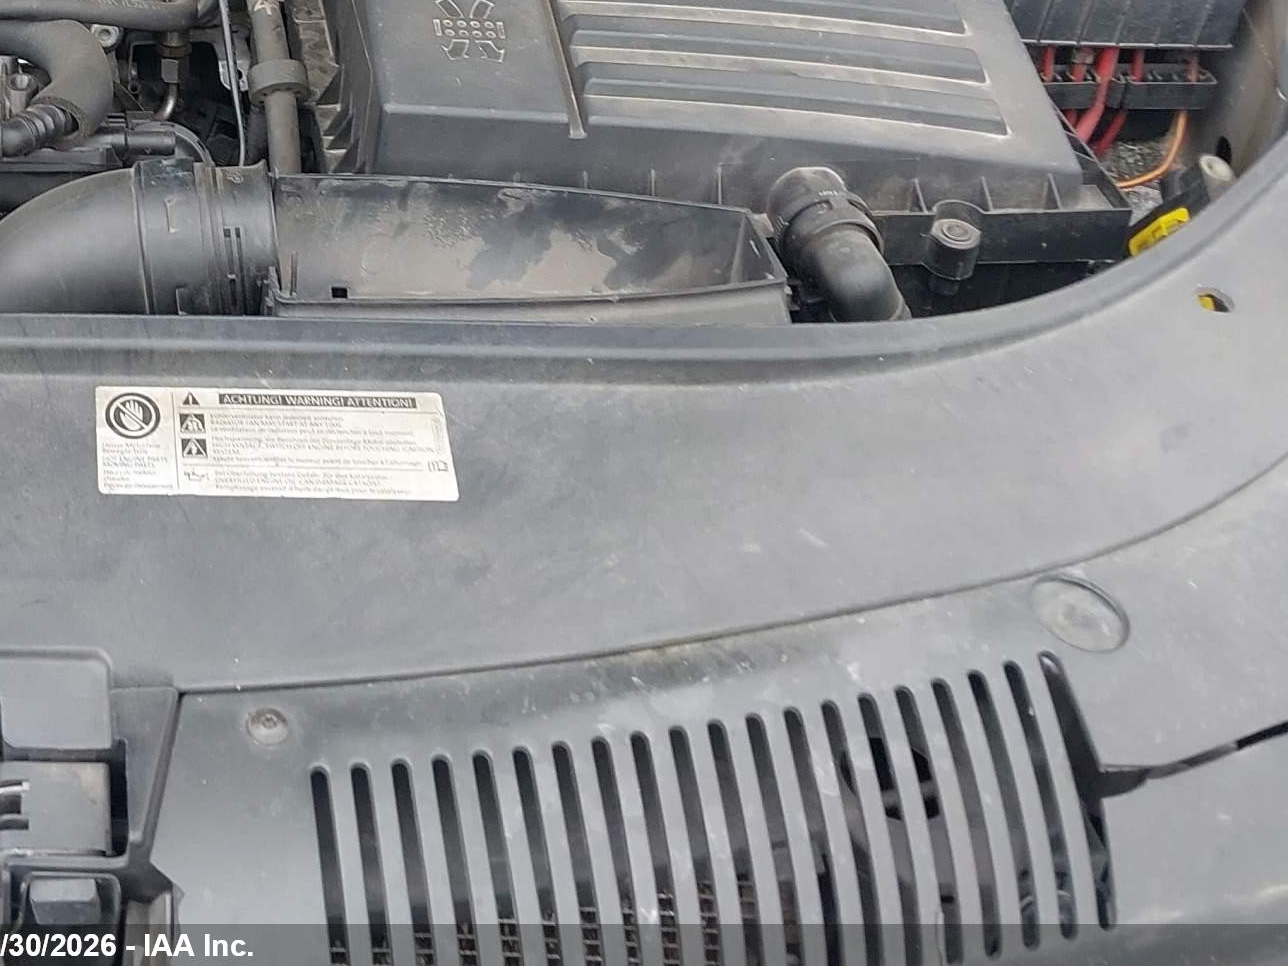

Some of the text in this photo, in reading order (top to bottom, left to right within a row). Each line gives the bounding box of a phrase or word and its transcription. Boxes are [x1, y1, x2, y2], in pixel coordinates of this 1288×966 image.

[223, 394, 413, 409] ACHTUNG! WARNING! ATTENTION!
